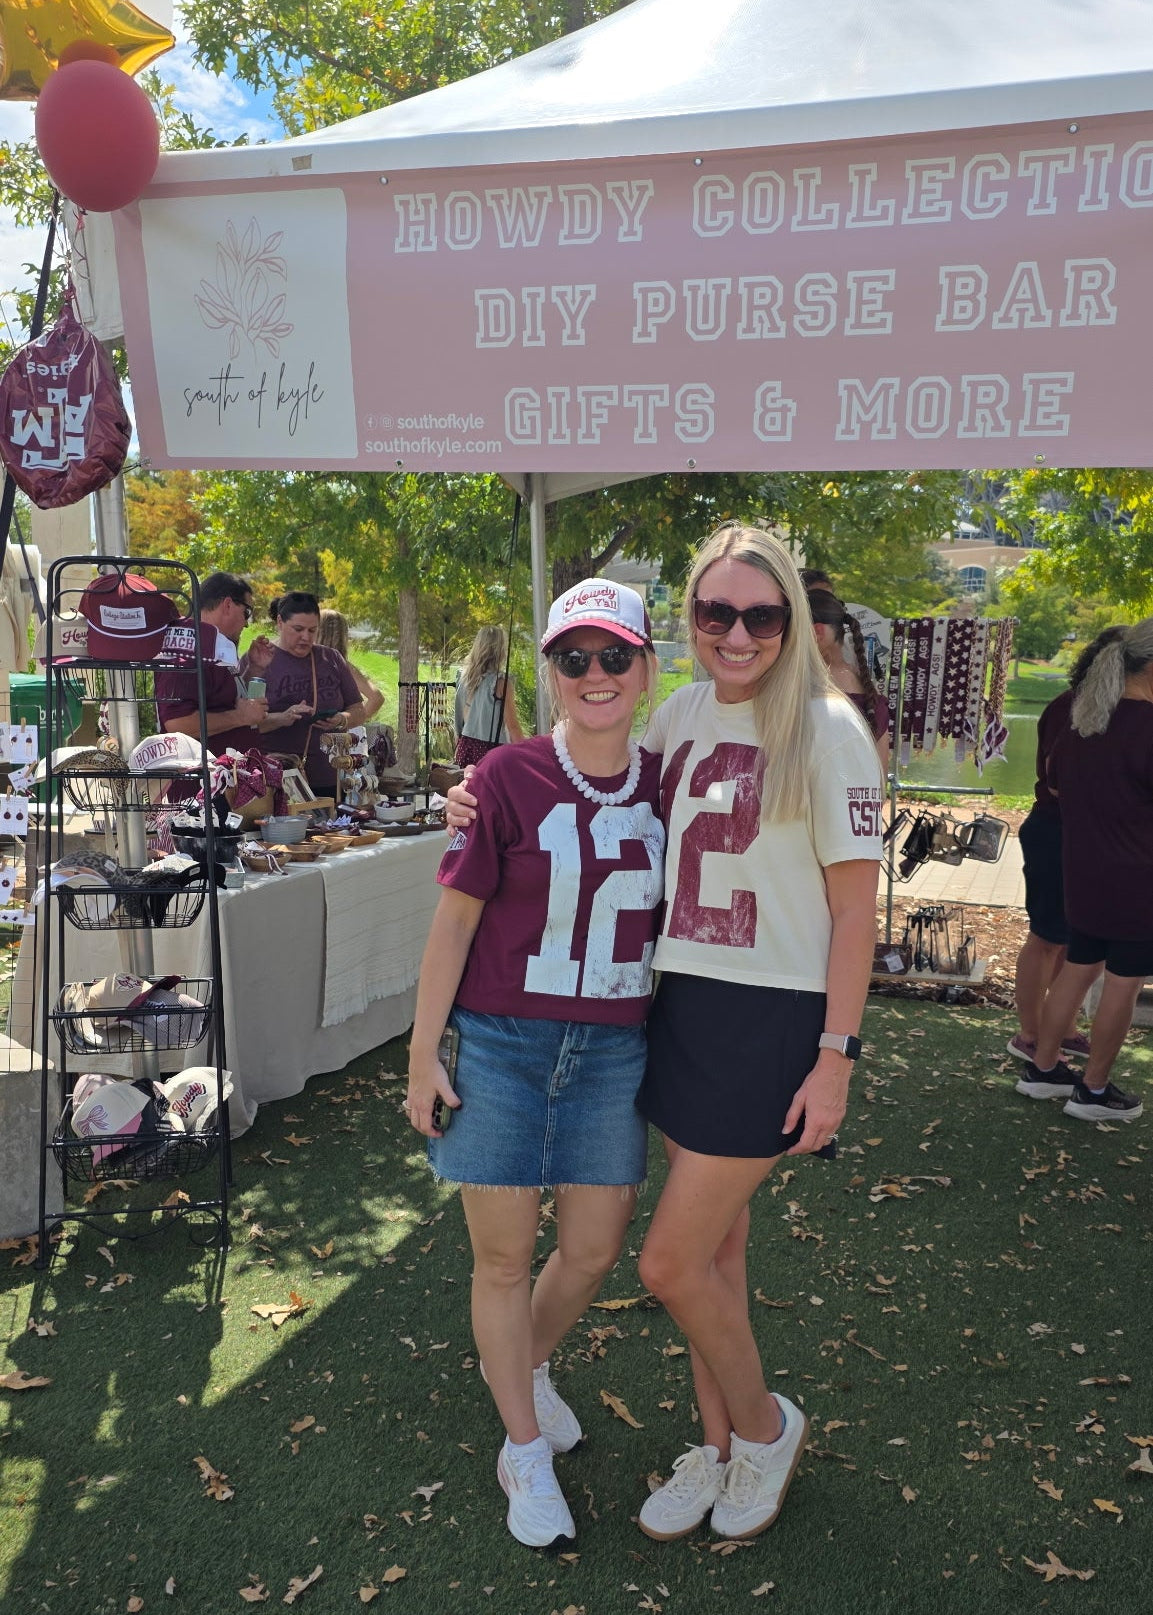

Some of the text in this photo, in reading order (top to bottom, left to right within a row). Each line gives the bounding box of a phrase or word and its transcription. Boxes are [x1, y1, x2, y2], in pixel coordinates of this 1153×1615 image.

[393, 179, 654, 253] HOWDY
[474, 258, 1117, 348] DIY PURSE BAR
[26, 354, 79, 381] gies
[184, 361, 324, 436] south of kyle
[504, 372, 1075, 445] GIFTS & MORE
[397, 414, 484, 433] southofkyle
[365, 437, 502, 457] southofkyle.com
[565, 586, 616, 613] Howdy
[62, 628, 89, 645] How
[165, 637, 195, 650] OACH
[892, 635, 904, 670] AGGIES
[903, 668, 914, 702] HOWDY
[916, 667, 926, 700] HOWDY
[927, 683, 938, 717] HOWDY
[888, 692, 898, 710] GIG
[848, 801, 883, 837] CST
[524, 801, 666, 999] 12
